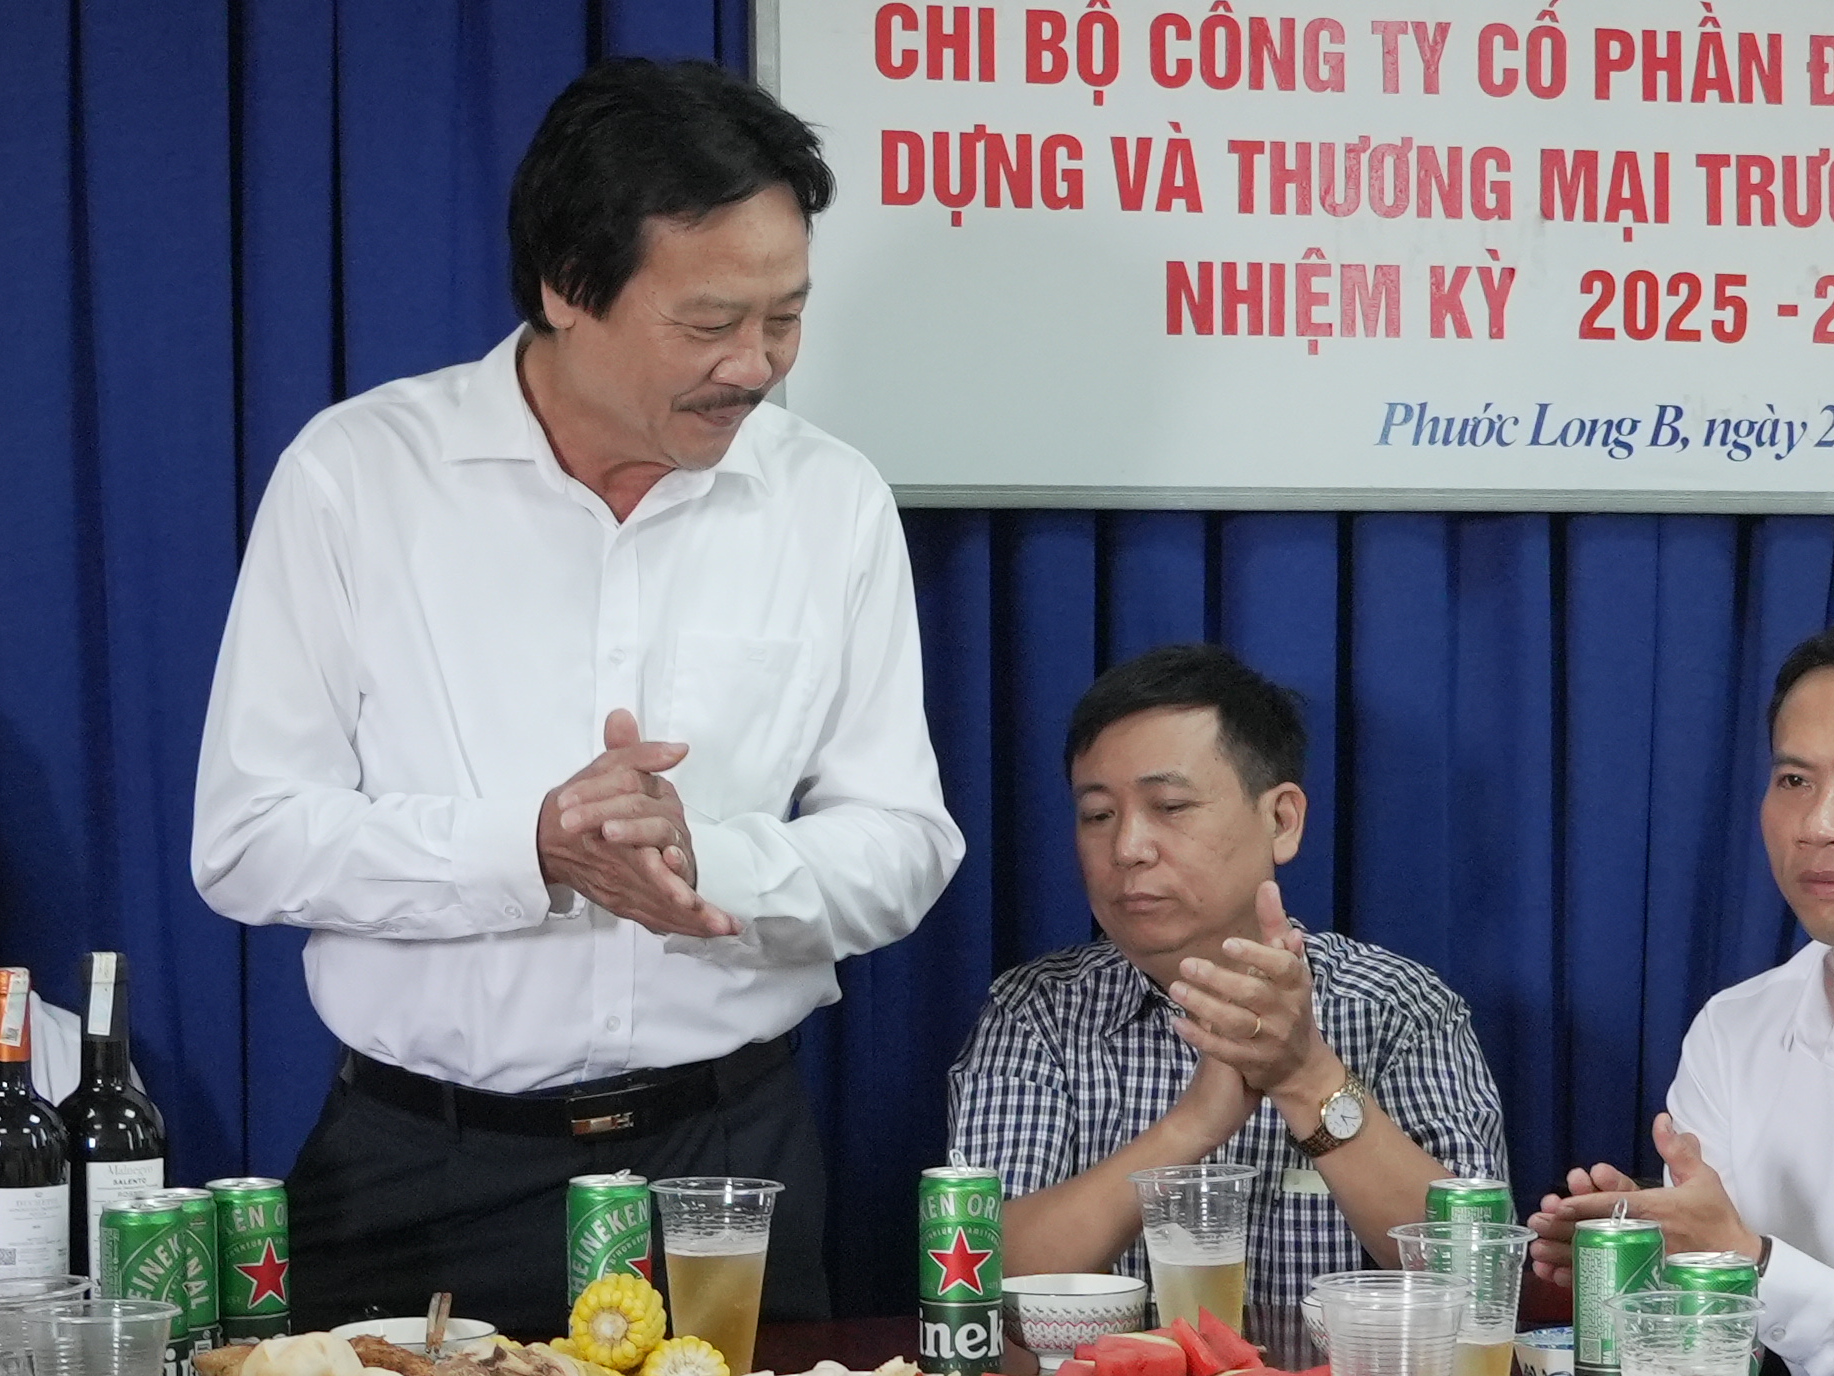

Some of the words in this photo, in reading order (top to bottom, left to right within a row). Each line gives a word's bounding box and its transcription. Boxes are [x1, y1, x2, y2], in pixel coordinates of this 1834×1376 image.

[875, 3, 996, 82] CHI
[1150, 0, 1345, 92] CÔNG
[1372, 21, 1451, 94] TY
[1595, 1, 1783, 105] PHẦN
[881, 124, 1084, 222] DỰNG
[1112, 121, 1203, 213] VÀ
[1228, 135, 1511, 221] THƯƠNG
[1540, 149, 1670, 242] MẠI
[1166, 248, 1400, 355] NHIỆM
[1430, 249, 1516, 339] KỲ
[1579, 270, 1748, 344] 2025
[1376, 402, 1519, 447] Phước
[1527, 403, 1641, 459] Long
[1647, 405, 1689, 453] B,
[1703, 418, 1807, 462] ngày
